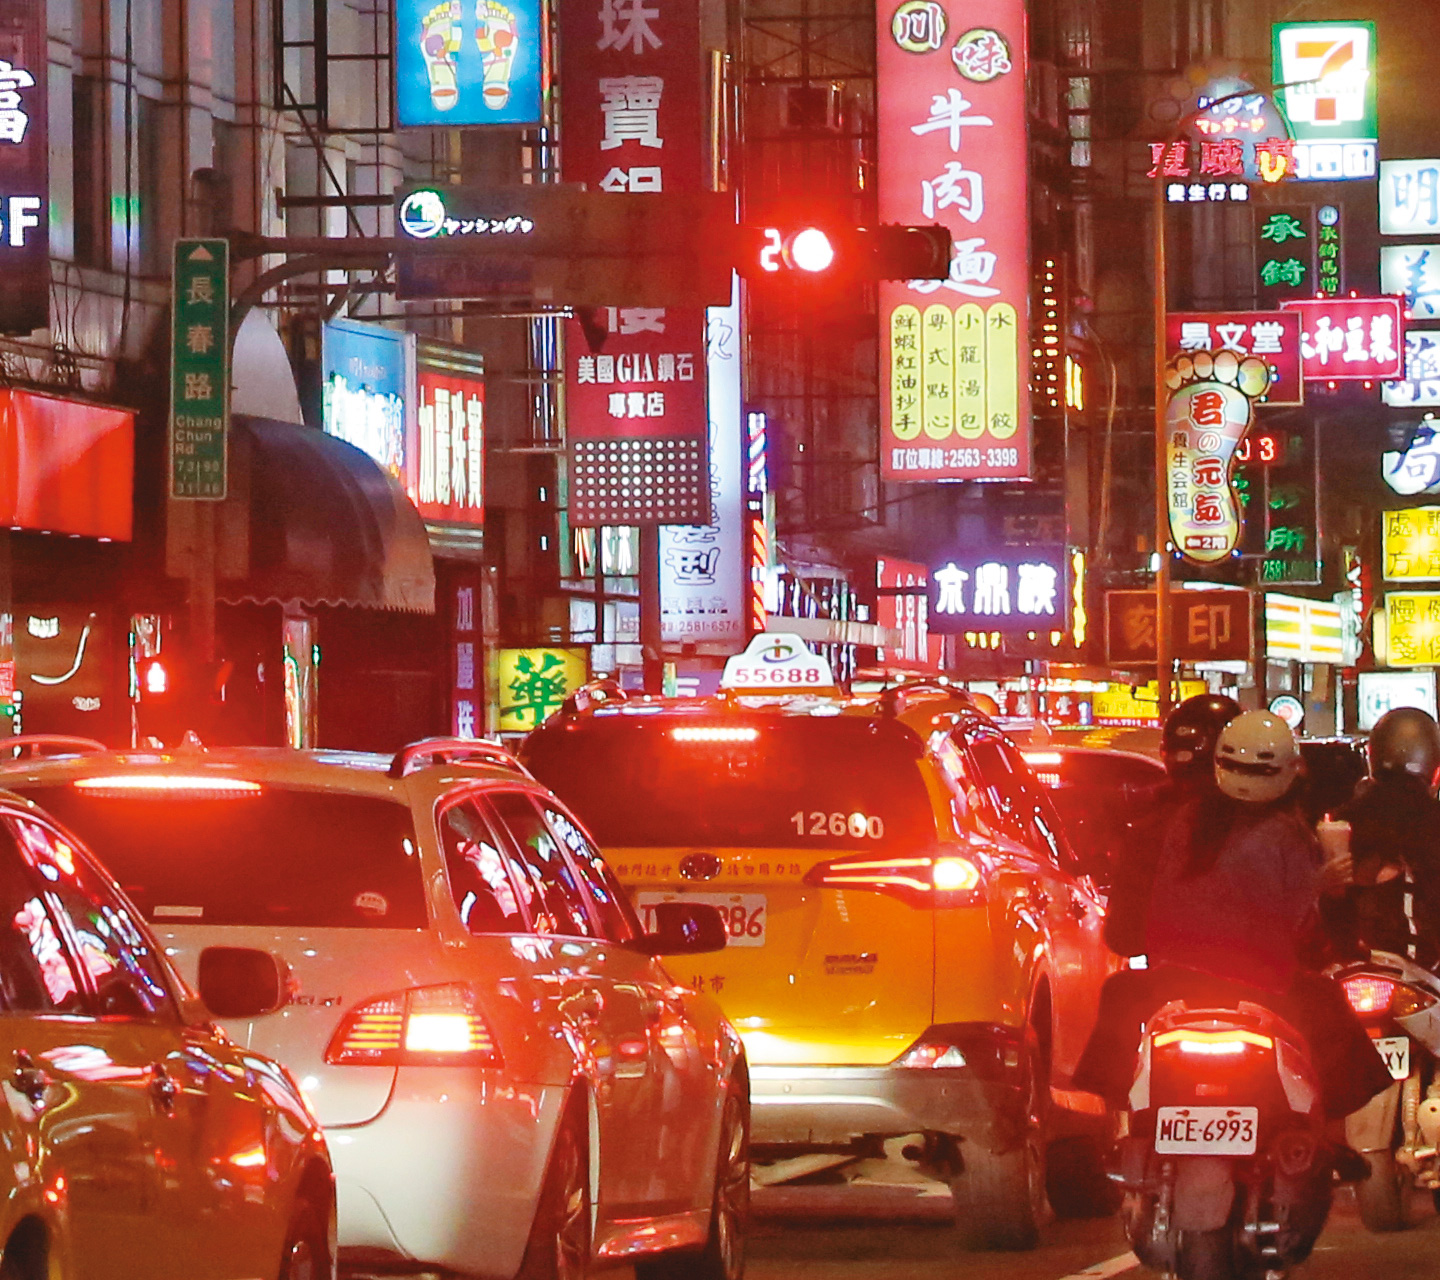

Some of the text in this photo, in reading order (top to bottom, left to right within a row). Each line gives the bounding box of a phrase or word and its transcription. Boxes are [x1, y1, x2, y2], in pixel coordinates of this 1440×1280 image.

[184, 275, 216, 402] 長春路
[734, 666, 821, 685] 55688
